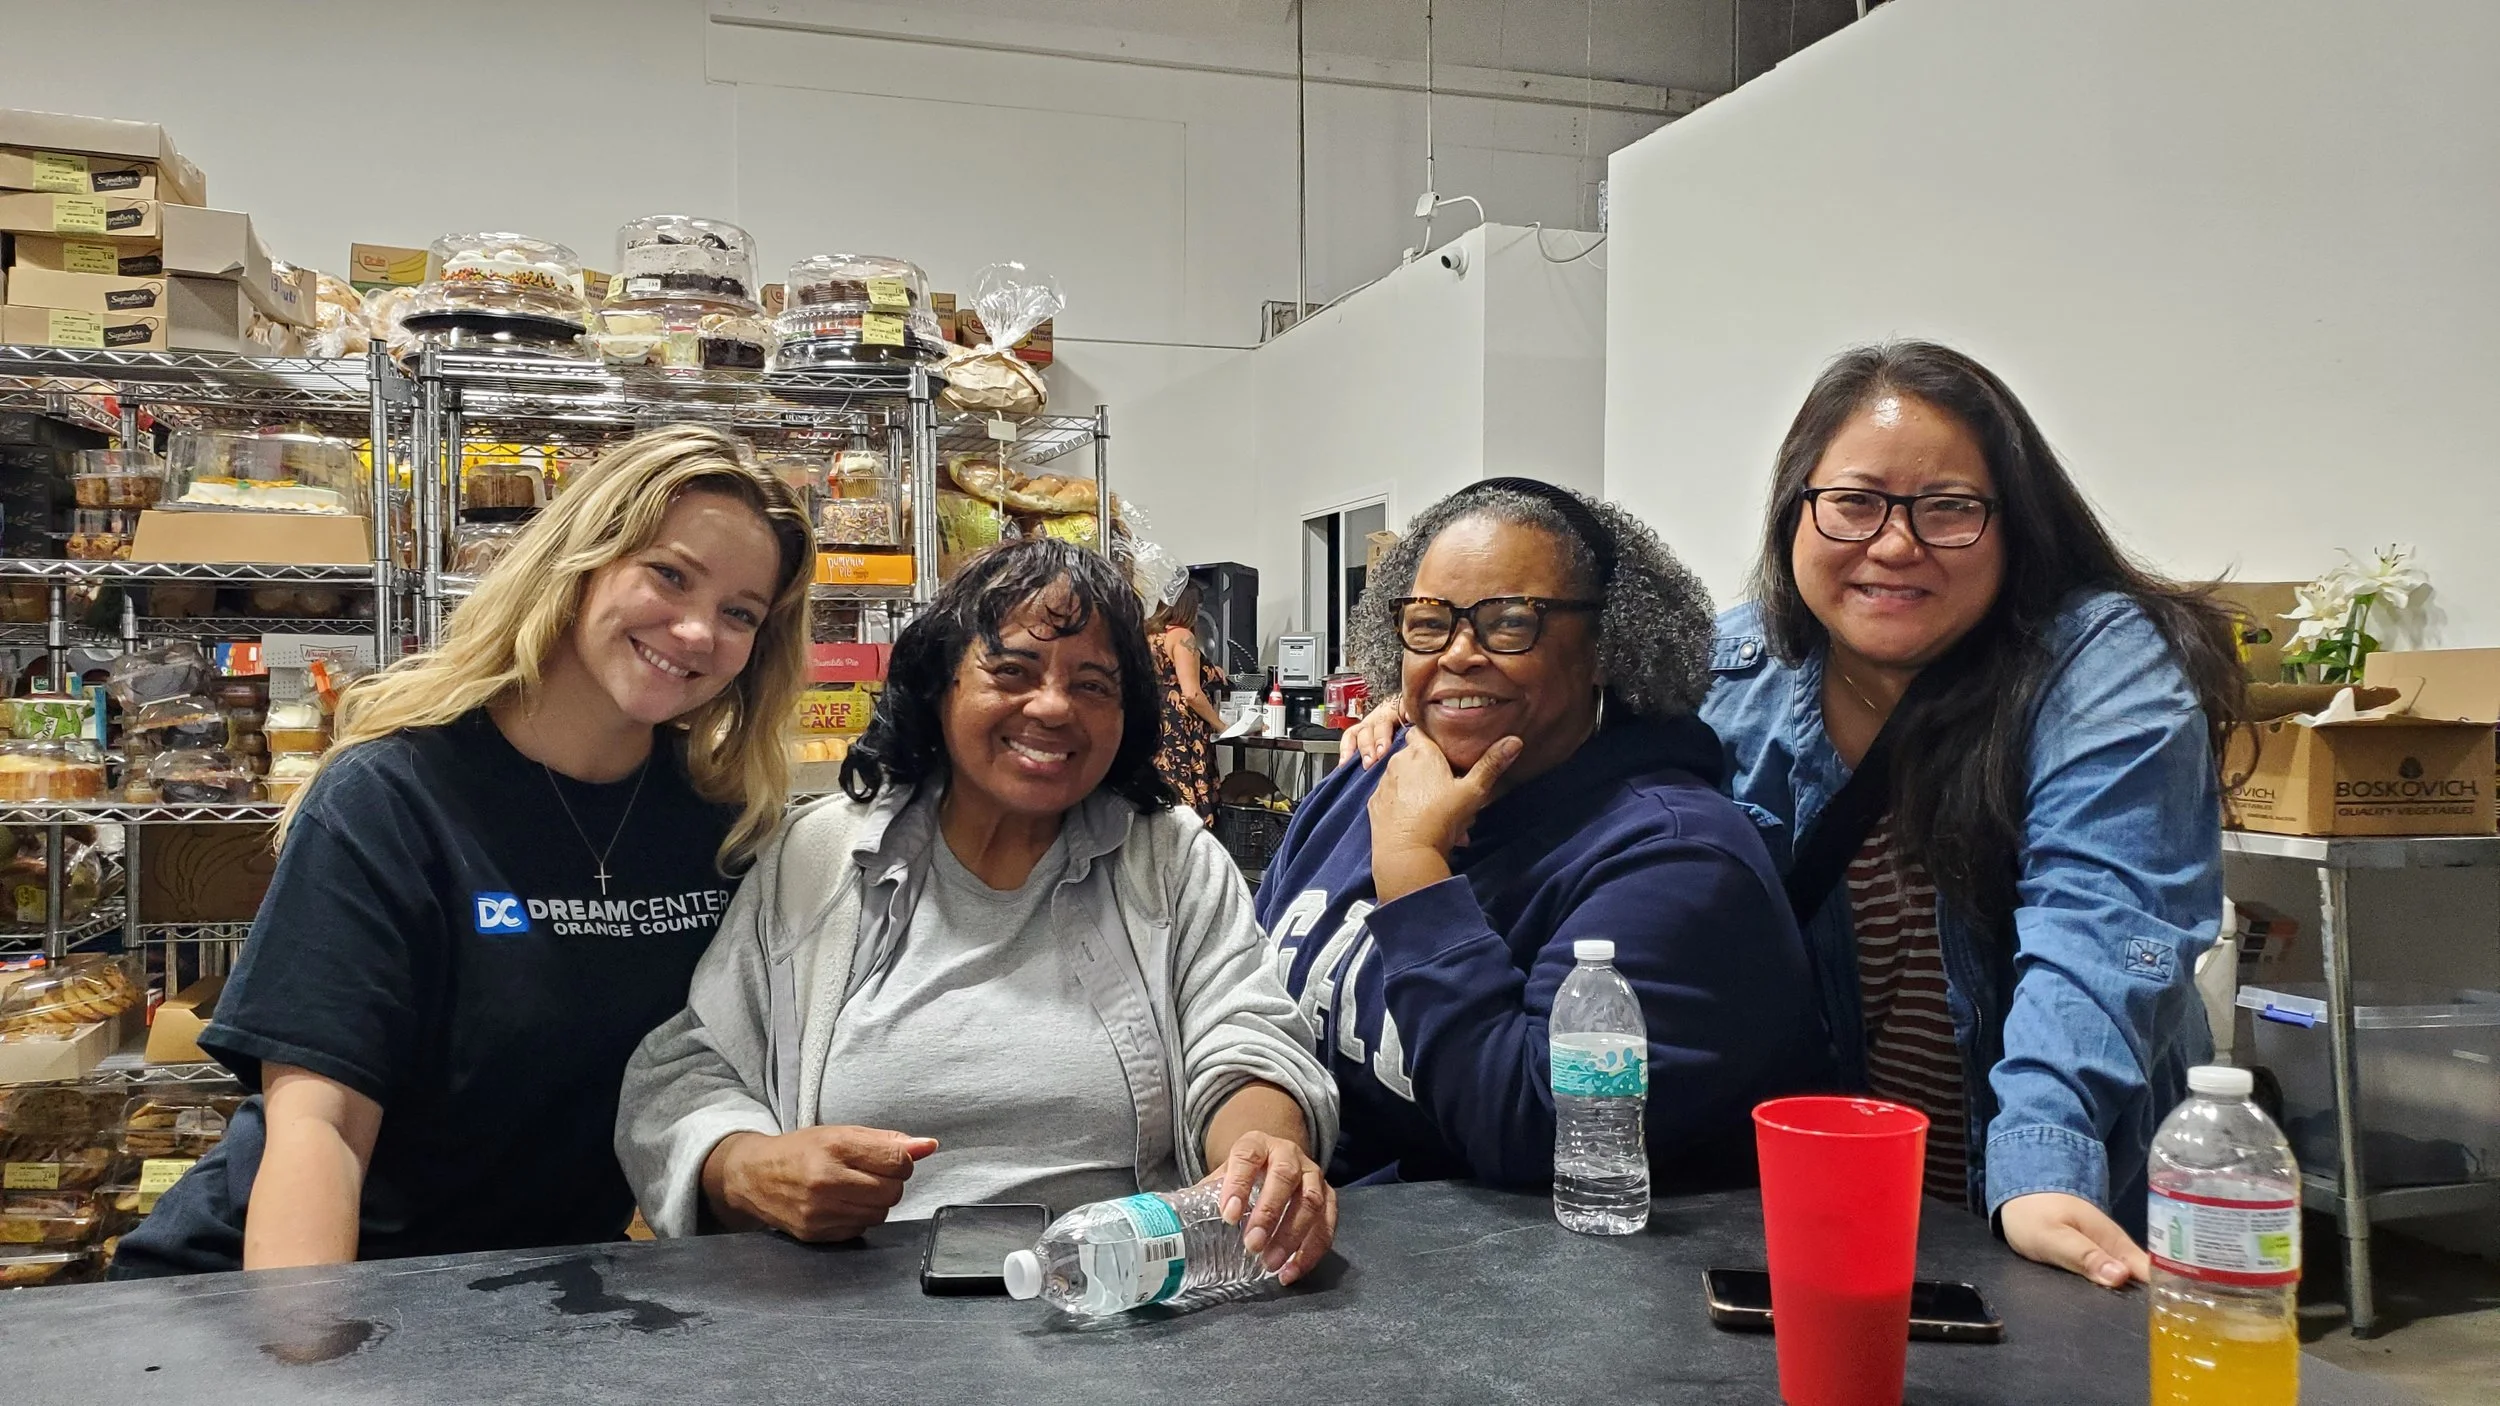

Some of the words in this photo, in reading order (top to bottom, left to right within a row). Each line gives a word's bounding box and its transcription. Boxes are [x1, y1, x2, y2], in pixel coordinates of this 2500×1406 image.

[800, 703, 851, 716] LAYER
[800, 716, 846, 729] CAKE
[2335, 779, 2479, 798] BOSKOVICH
[2337, 806, 2392, 817] QUALITY
[2396, 806, 2475, 816] VEGETABLES
[478, 897, 523, 928] DC
[553, 921, 634, 937] ORANGE
[639, 913, 720, 936] COUNTY
